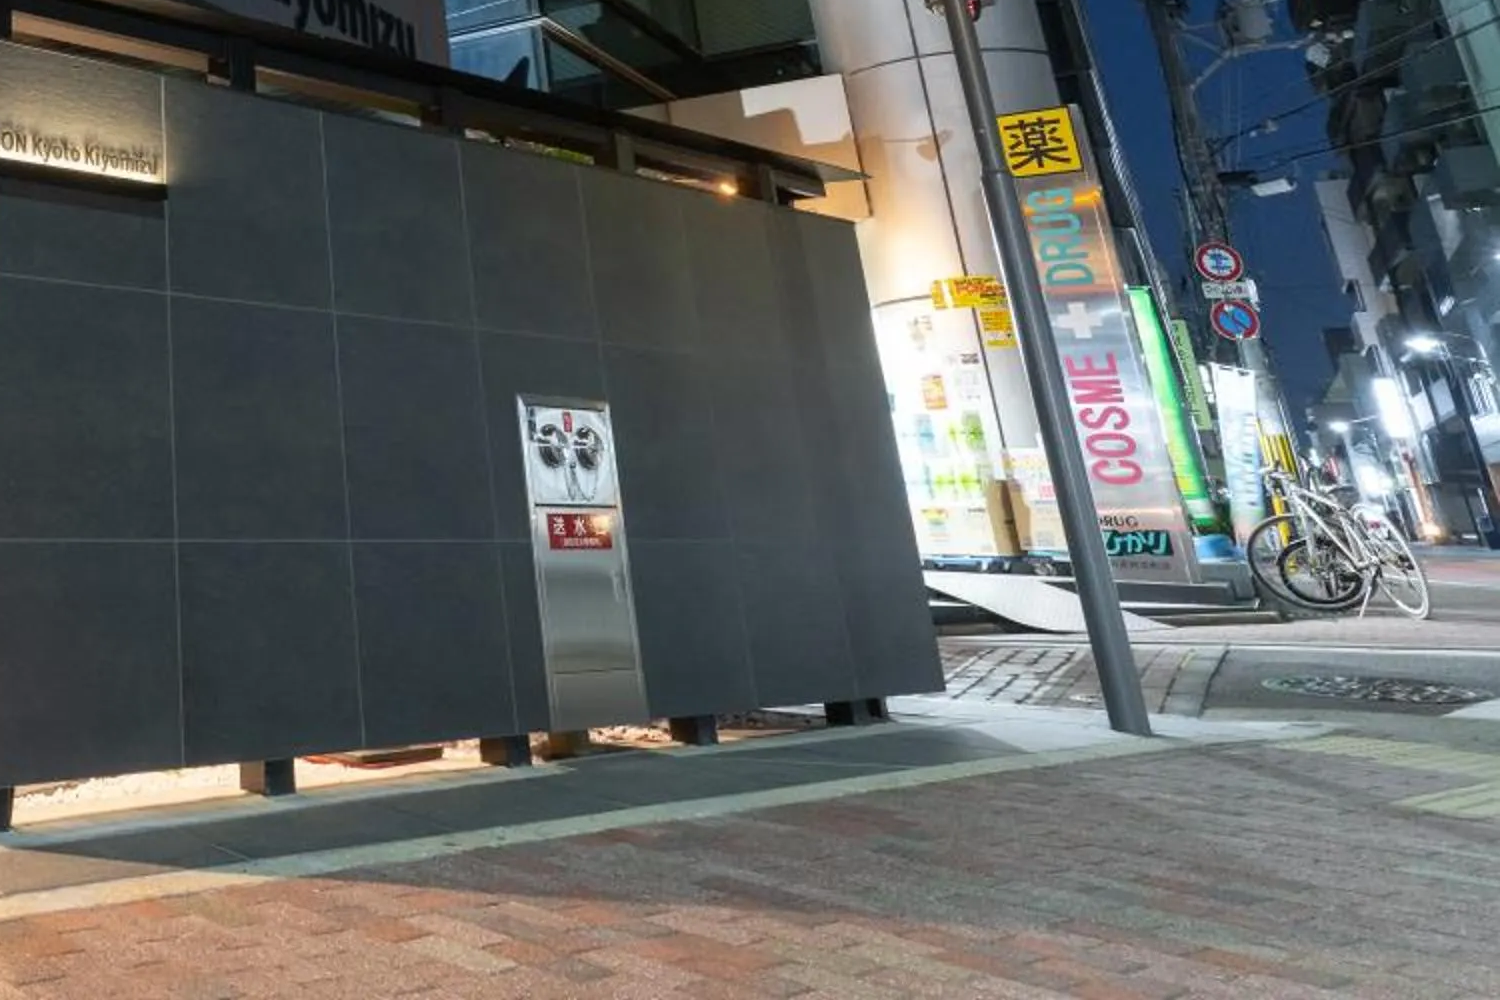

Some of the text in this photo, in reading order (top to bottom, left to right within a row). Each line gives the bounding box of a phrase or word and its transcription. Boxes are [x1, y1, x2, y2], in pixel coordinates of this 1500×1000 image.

[32, 134, 81, 162] Kyoto
[85, 143, 158, 175] Kiyomizu
[1003, 117, 1072, 170] 薬
[1027, 187, 1094, 286] DRUG
[1064, 352, 1143, 485] COSME
[1100, 515, 1138, 528] RUG
